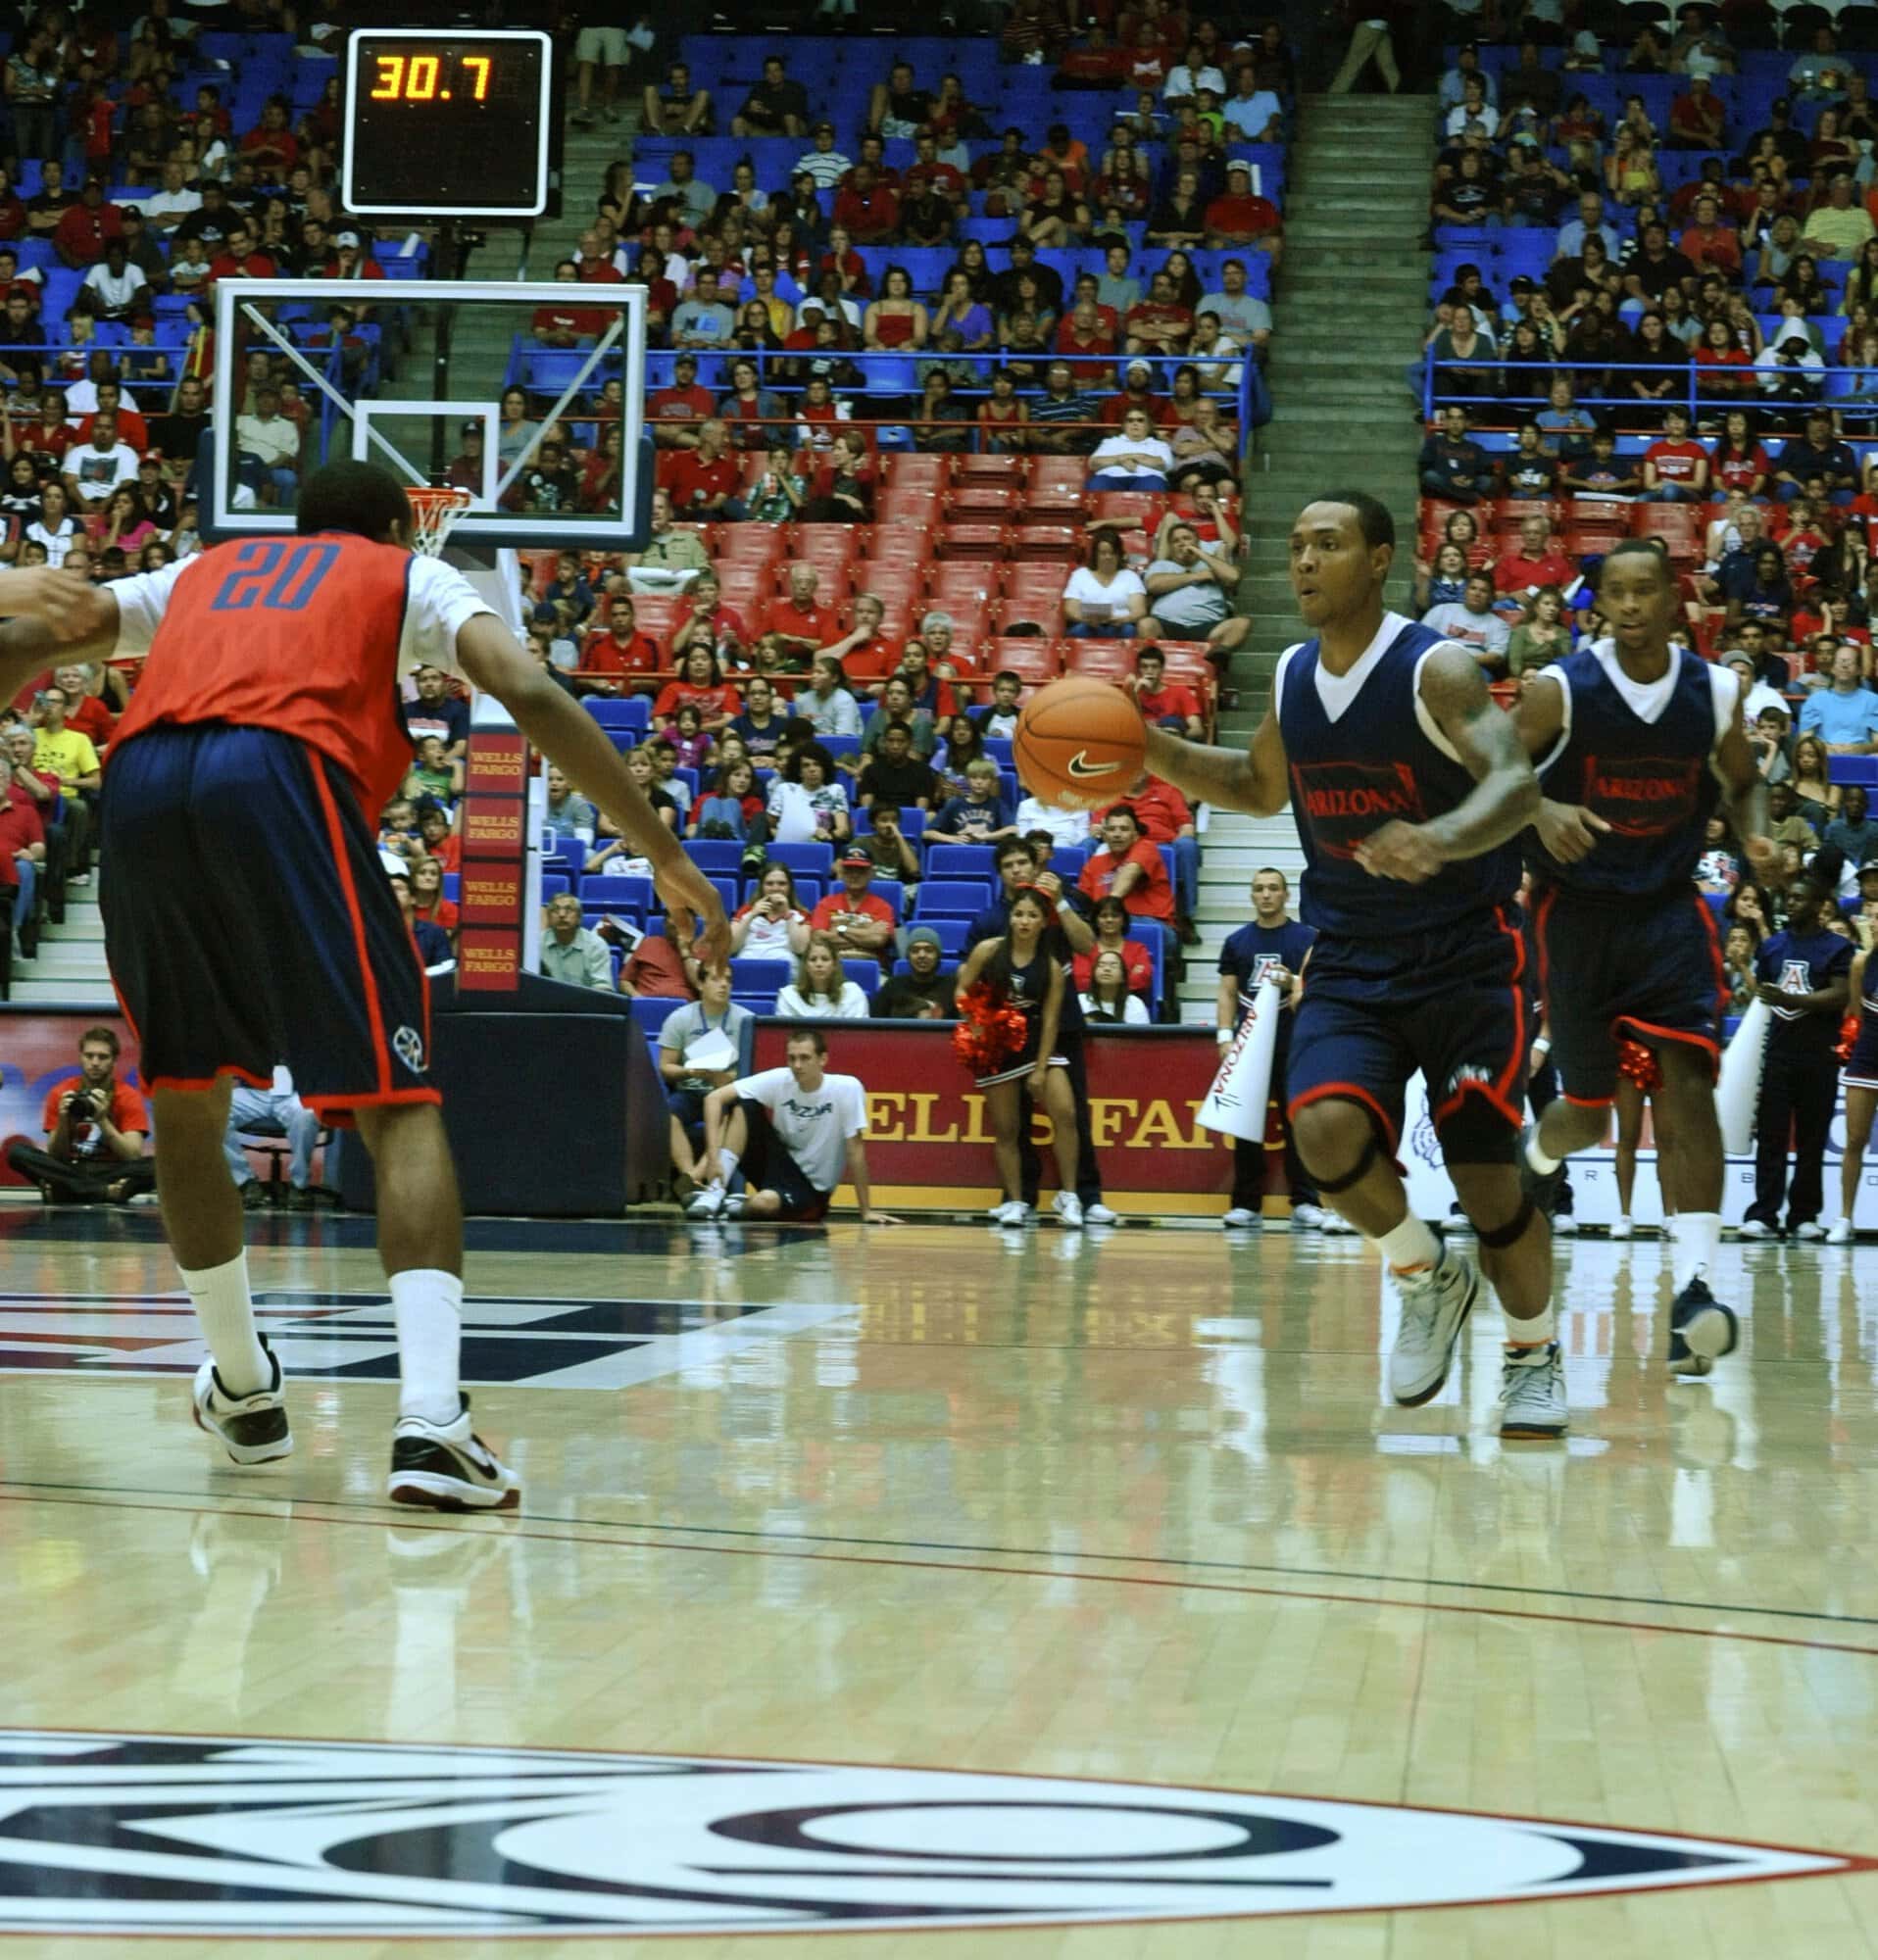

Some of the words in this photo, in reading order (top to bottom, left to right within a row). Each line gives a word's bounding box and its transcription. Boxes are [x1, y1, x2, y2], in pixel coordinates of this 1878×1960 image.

[371, 56, 490, 99] 30.7
[211, 542, 342, 611] 20
[470, 752, 524, 763] WELLS
[470, 764, 520, 775] FARGO
[469, 815, 519, 827] WELLS
[469, 828, 519, 839] FARGO
[465, 881, 518, 893] WELLS
[466, 894, 516, 906] FARGO
[464, 948, 516, 959] WELLS
[465, 960, 515, 973] FARGO
[1775, 959, 1813, 995] A
[1212, 1009, 1258, 1095] ARIZONA
